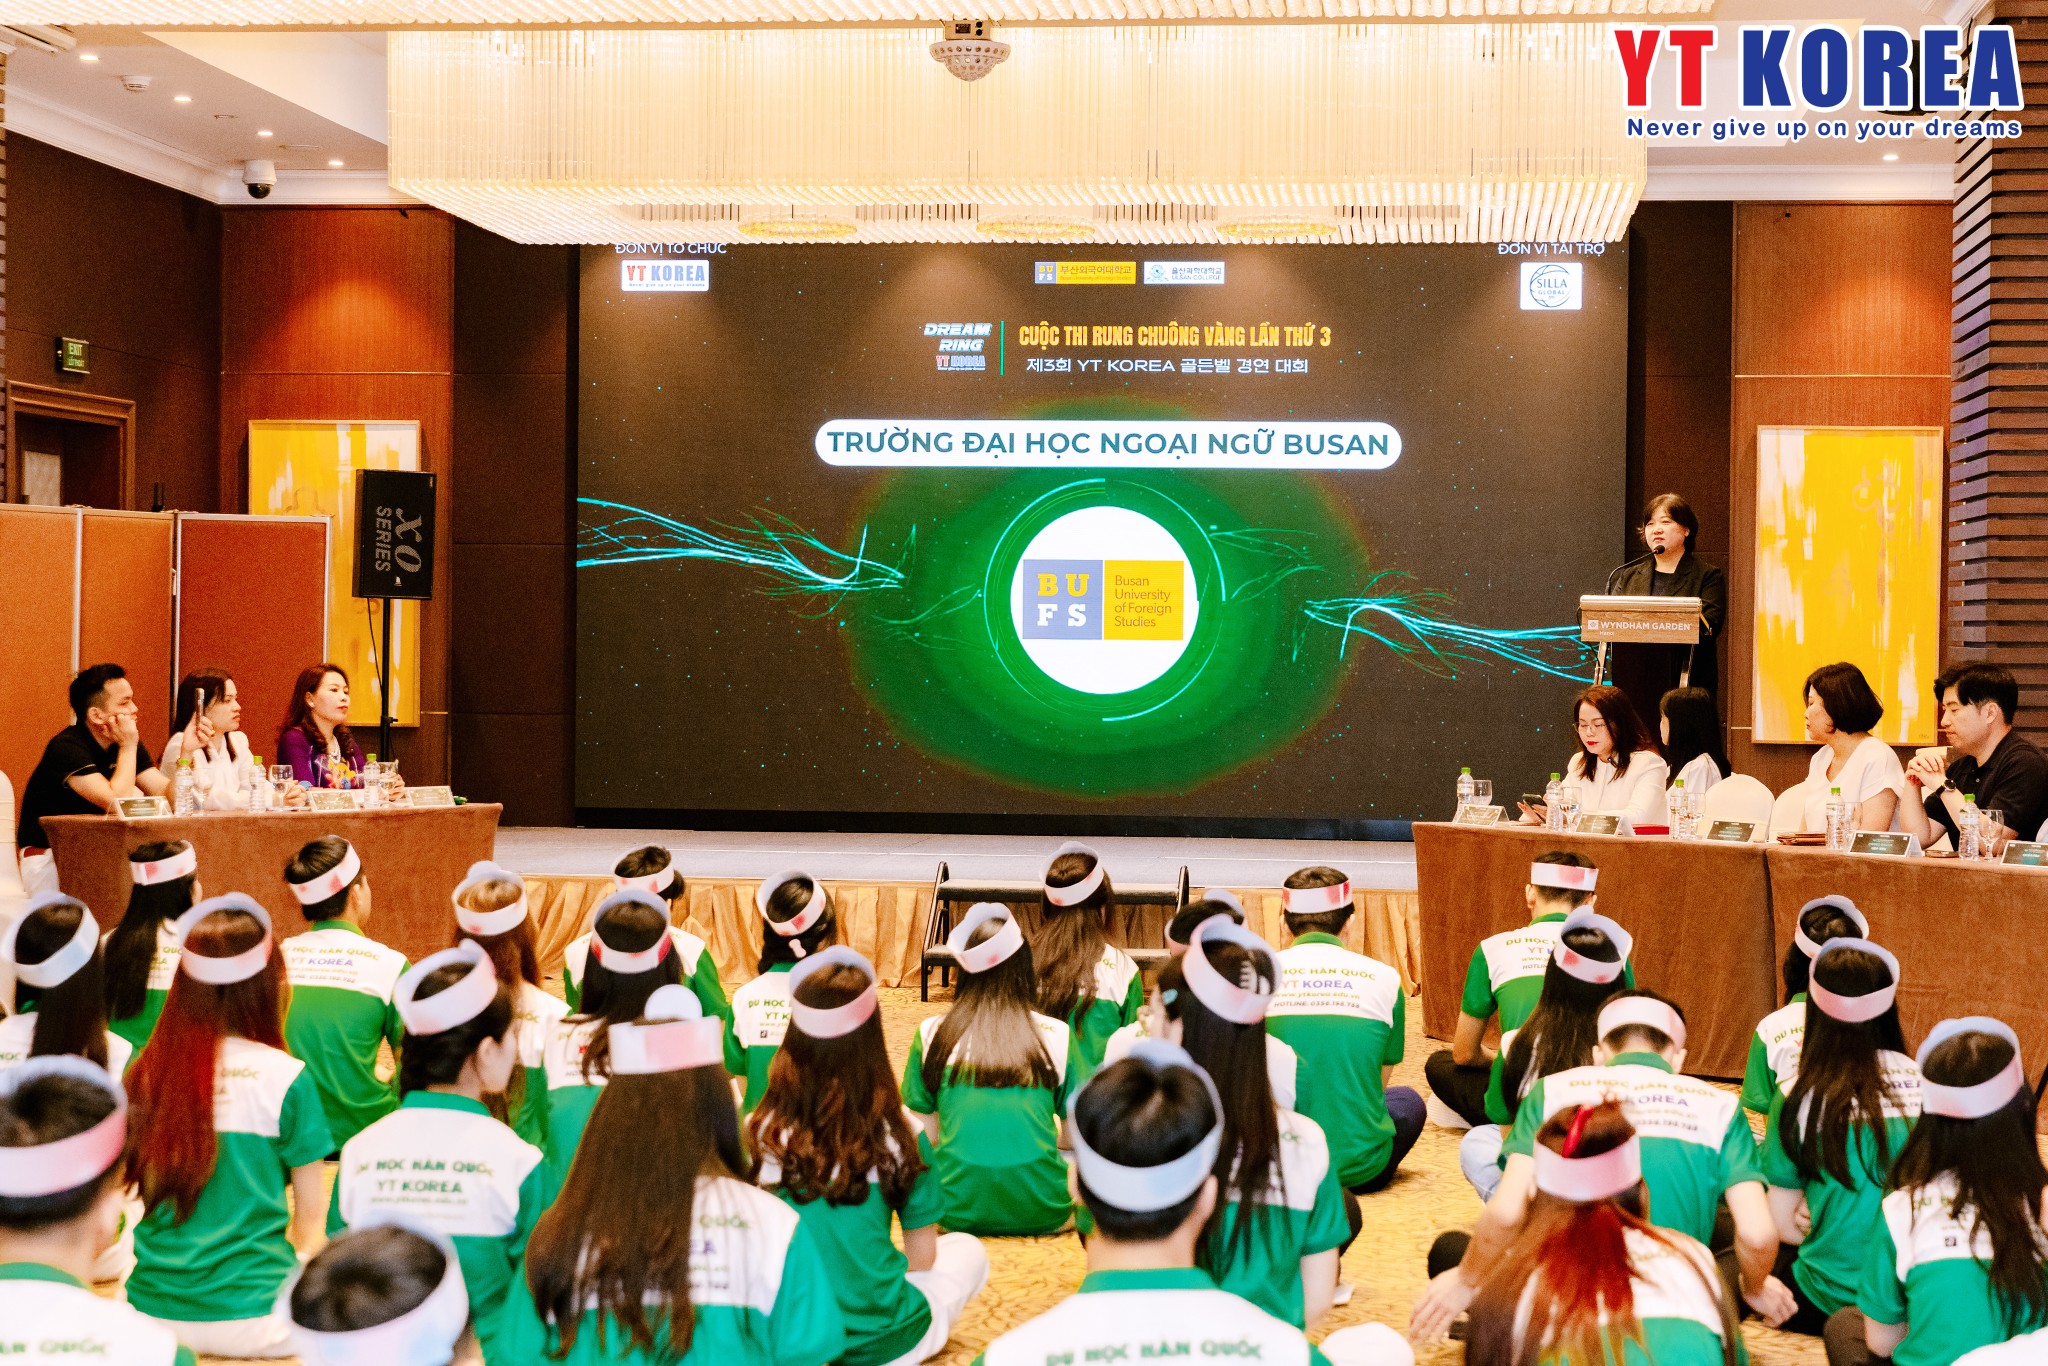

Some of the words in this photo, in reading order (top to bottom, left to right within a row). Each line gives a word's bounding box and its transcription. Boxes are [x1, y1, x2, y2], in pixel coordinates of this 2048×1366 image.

[1534, 243, 1548, 256] VỊ
[627, 265, 647, 281] YT
[651, 265, 705, 281] KOREA
[1060, 265, 1132, 275] 부산외국어대학교
[1537, 279, 1567, 288] SILLA
[924, 323, 992, 336] DREAM
[1019, 320, 1060, 350] CUỘC
[1064, 326, 1088, 346] THI
[1092, 326, 1133, 346] RUNG
[1138, 320, 1200, 346] CHUÔNG
[1204, 321, 1245, 346] VÀNG
[1320, 326, 1331, 346] 3
[68, 342, 83, 356] EXIT
[938, 338, 985, 352] RING
[936, 355, 950, 367] YT
[950, 355, 986, 367] KOREA
[1027, 358, 1072, 373] 제3회
[1077, 359, 1102, 372] YT
[1107, 359, 1175, 372] KOREA
[1180, 358, 1231, 373] 골든벨
[1236, 358, 1269, 373] 경연
[1275, 358, 1308, 373] 대회
[827, 426, 953, 453] TRƯỜNG
[962, 432, 1015, 459] ĐẠI
[1026, 432, 1091, 459] HỌC
[1101, 433, 1197, 460] NGOẠI
[1208, 428, 1275, 455] NGỮ
[1284, 434, 1388, 456] BUSAN
[375, 505, 392, 572] SERIES
[1115, 575, 1149, 586] Busan
[1114, 588, 1171, 602] University
[1114, 602, 1126, 613] of
[1128, 602, 1172, 616] Foreign
[1114, 615, 1156, 627] Studies
[1600, 621, 1650, 630] WYNDHAM
[1652, 622, 1690, 631] GARDEN
[308, 958, 353, 966] KOREA
[1282, 980, 1299, 989] YT
[1302, 980, 1353, 989] KOREA
[748, 1000, 760, 1008] DU
[1774, 1030, 1787, 1043] DU
[378, 1180, 396, 1190] YT
[402, 1180, 462, 1193] KOREA
